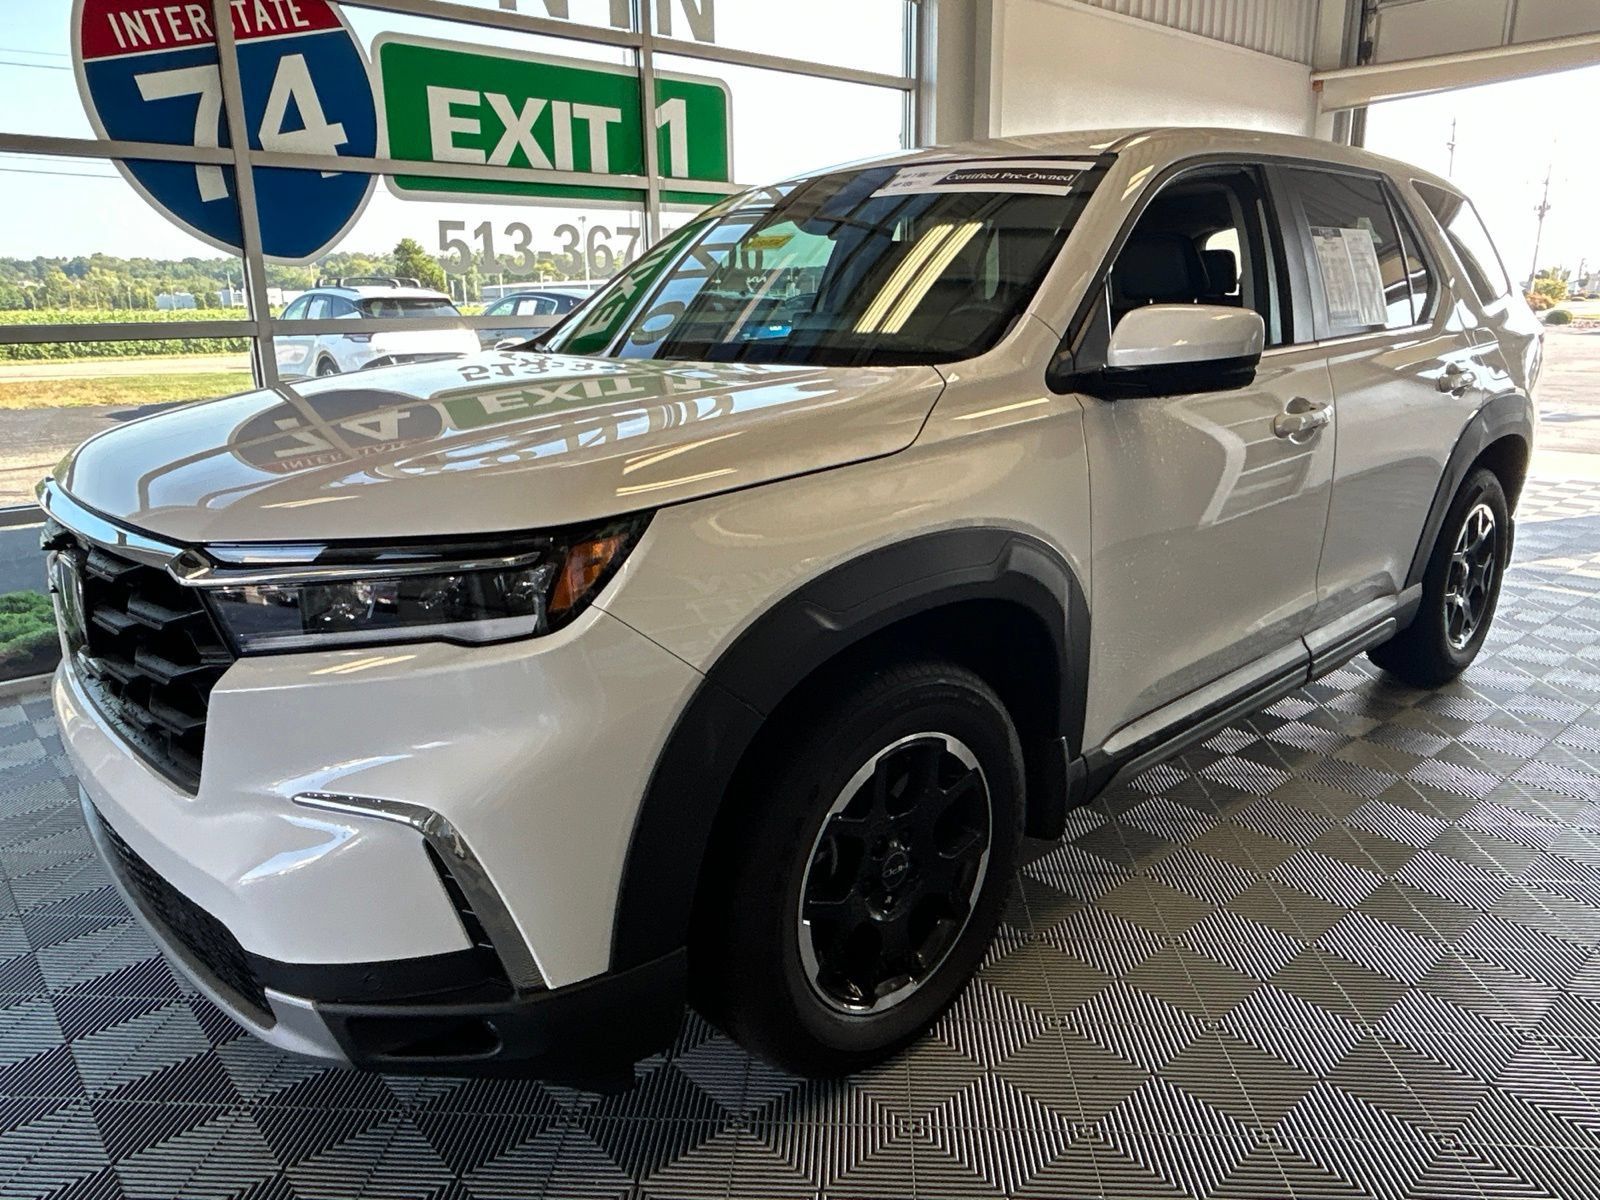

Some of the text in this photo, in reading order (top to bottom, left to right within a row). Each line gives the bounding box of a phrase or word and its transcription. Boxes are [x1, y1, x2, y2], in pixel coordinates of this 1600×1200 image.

[107, 0, 310, 49] INTERTATE
[134, 53, 349, 203] 74
[426, 85, 689, 178] EXIT 1
[946, 171, 1073, 182] Certified Pre-Owned
